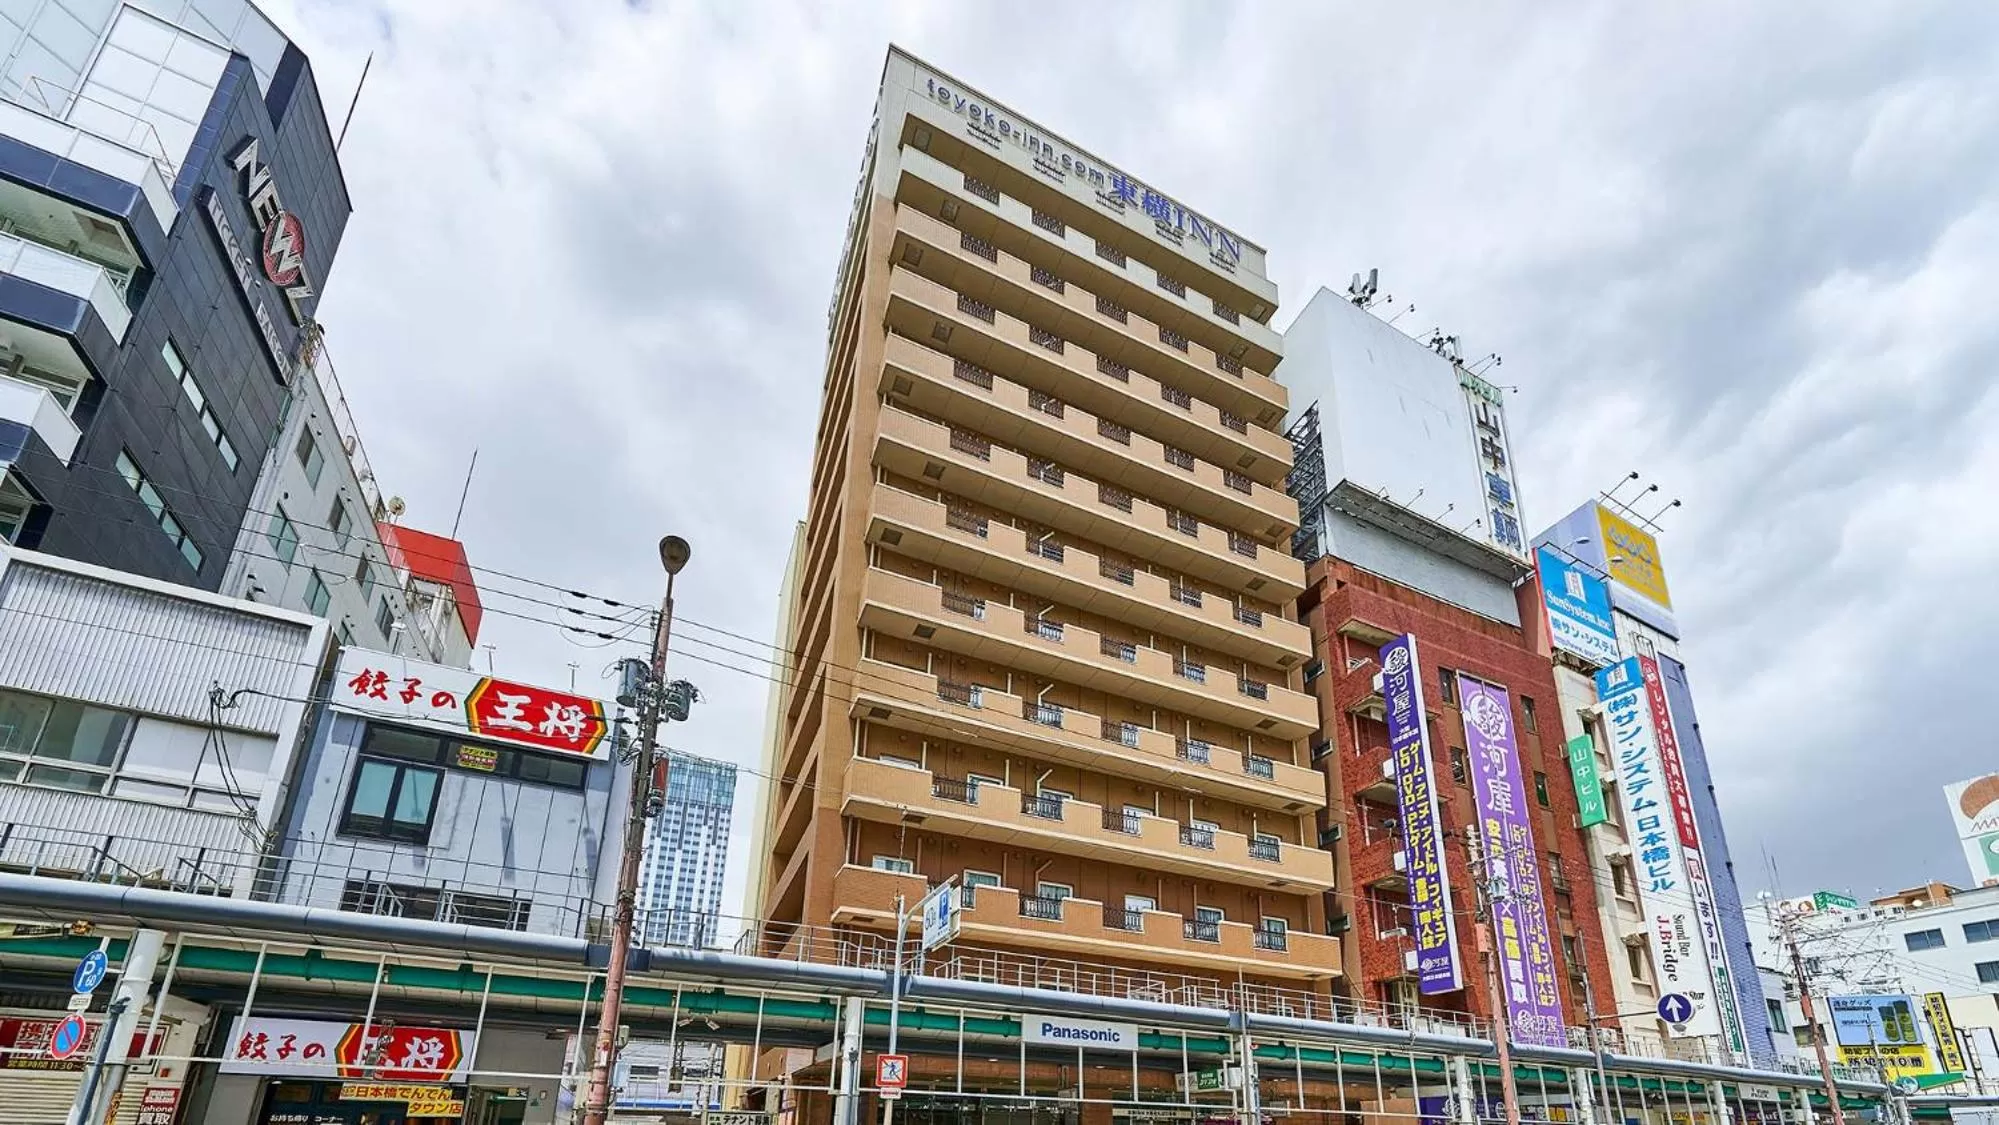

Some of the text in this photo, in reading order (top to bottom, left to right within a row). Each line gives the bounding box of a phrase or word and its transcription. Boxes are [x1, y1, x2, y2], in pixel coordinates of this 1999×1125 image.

[1108, 171, 1242, 263] 東横INN
[208, 192, 250, 289] TICKET
[1573, 747, 1597, 814] 山中ビル
[77, 960, 96, 989] P
[1041, 1022, 1121, 1042] Panasonic
[138, 1112, 171, 1125] 買取
[409, 1102, 462, 1114] タウン店
